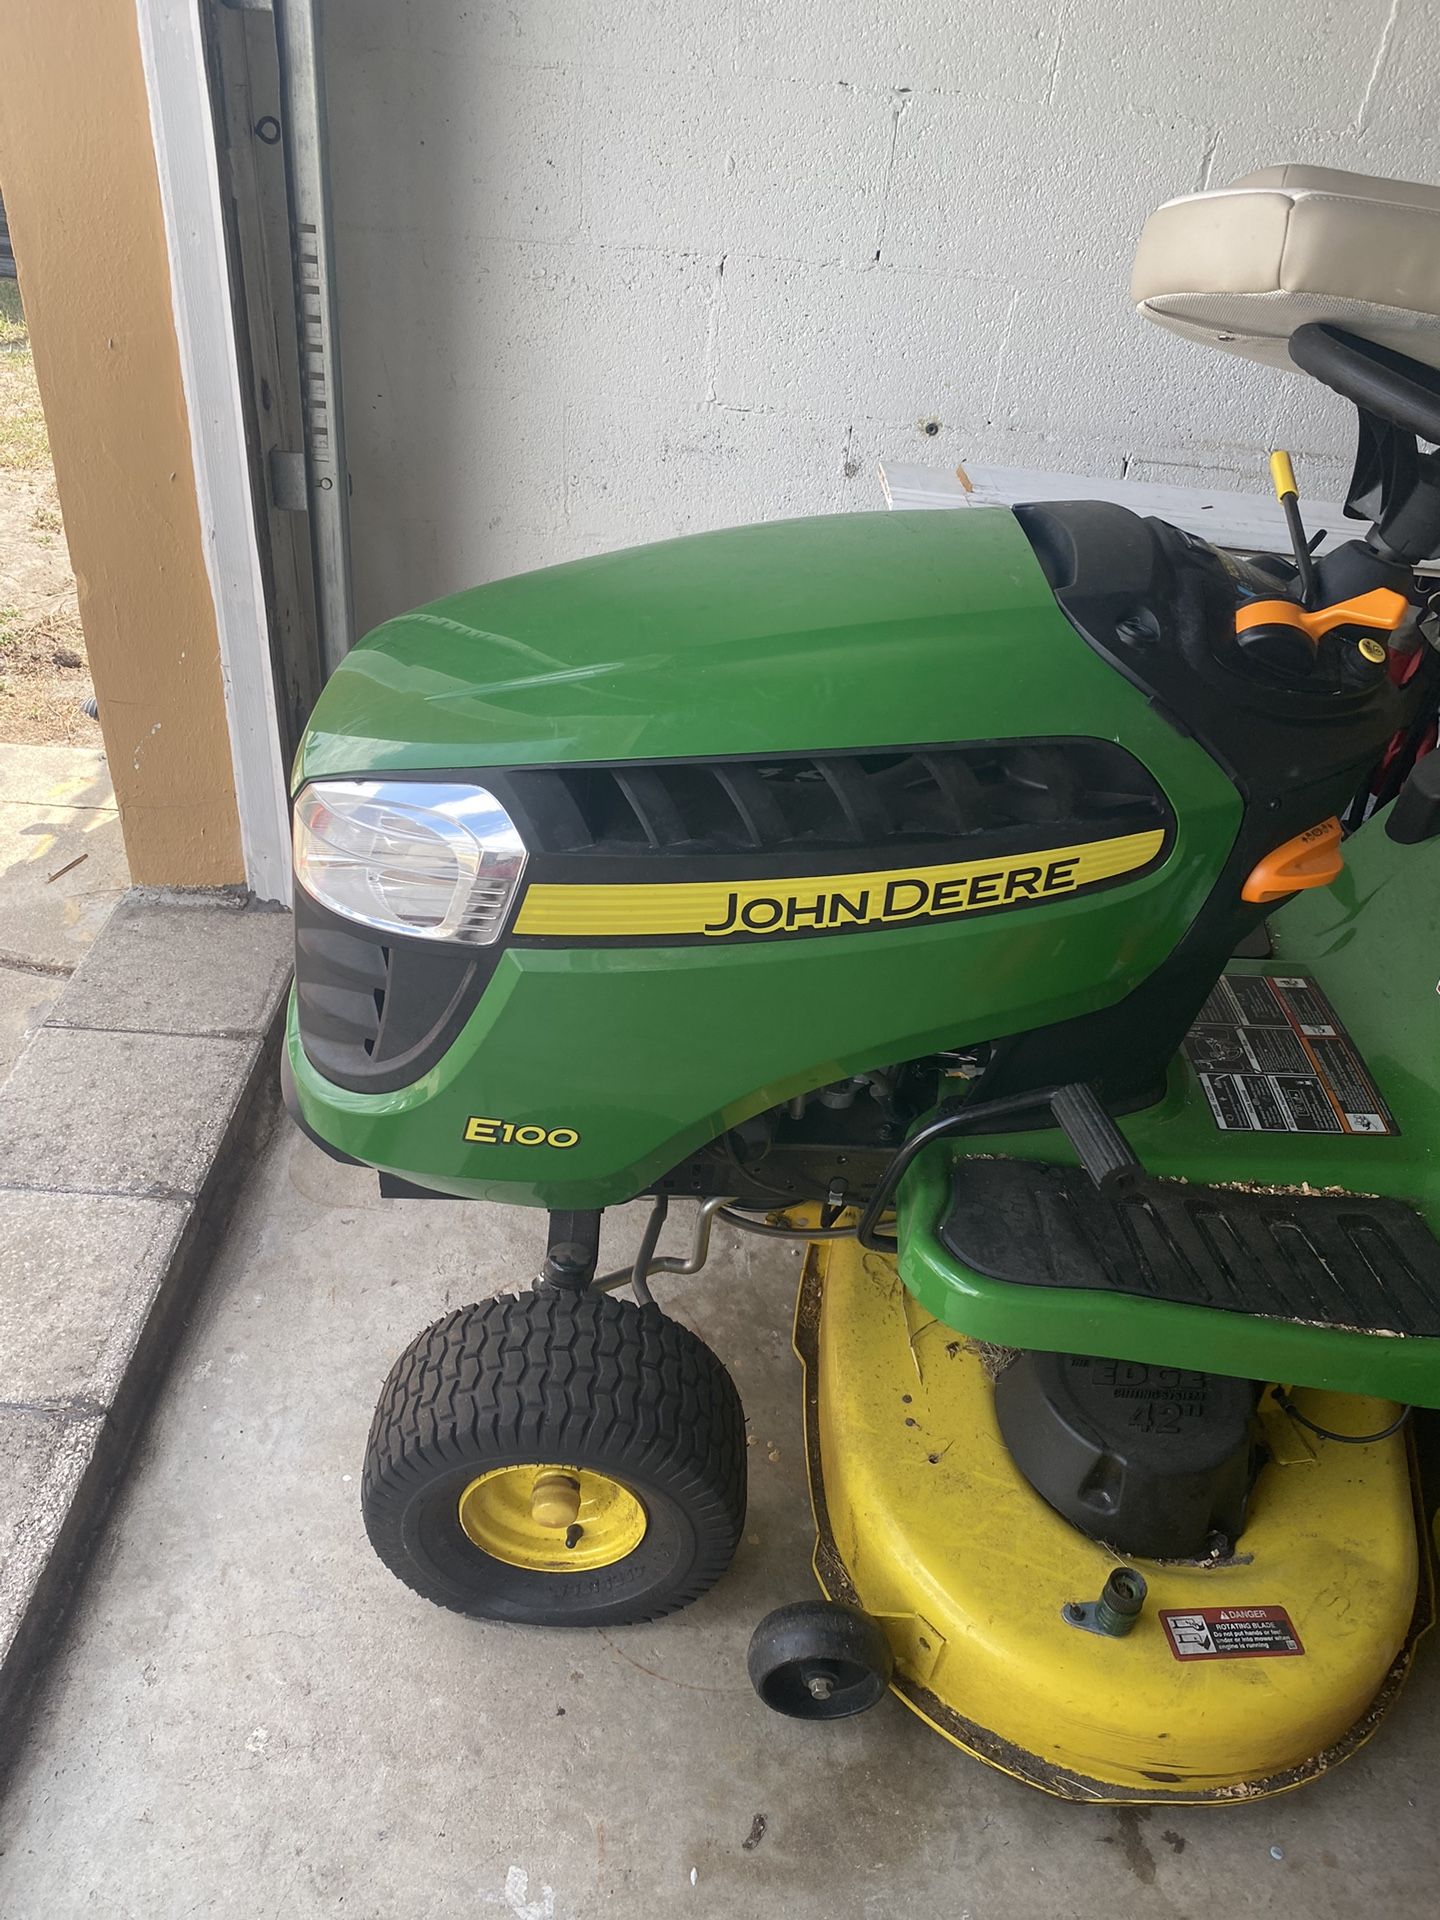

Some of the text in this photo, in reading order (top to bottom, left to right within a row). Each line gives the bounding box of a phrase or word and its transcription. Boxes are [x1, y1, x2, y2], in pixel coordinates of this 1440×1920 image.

[704, 857, 1081, 932] JOHN DEERE
[464, 1116, 580, 1148] E100
[1092, 1359, 1206, 1389] EDGE
[1215, 1623, 1252, 1631] ROTATING
[1229, 1610, 1267, 1619] DANGER
